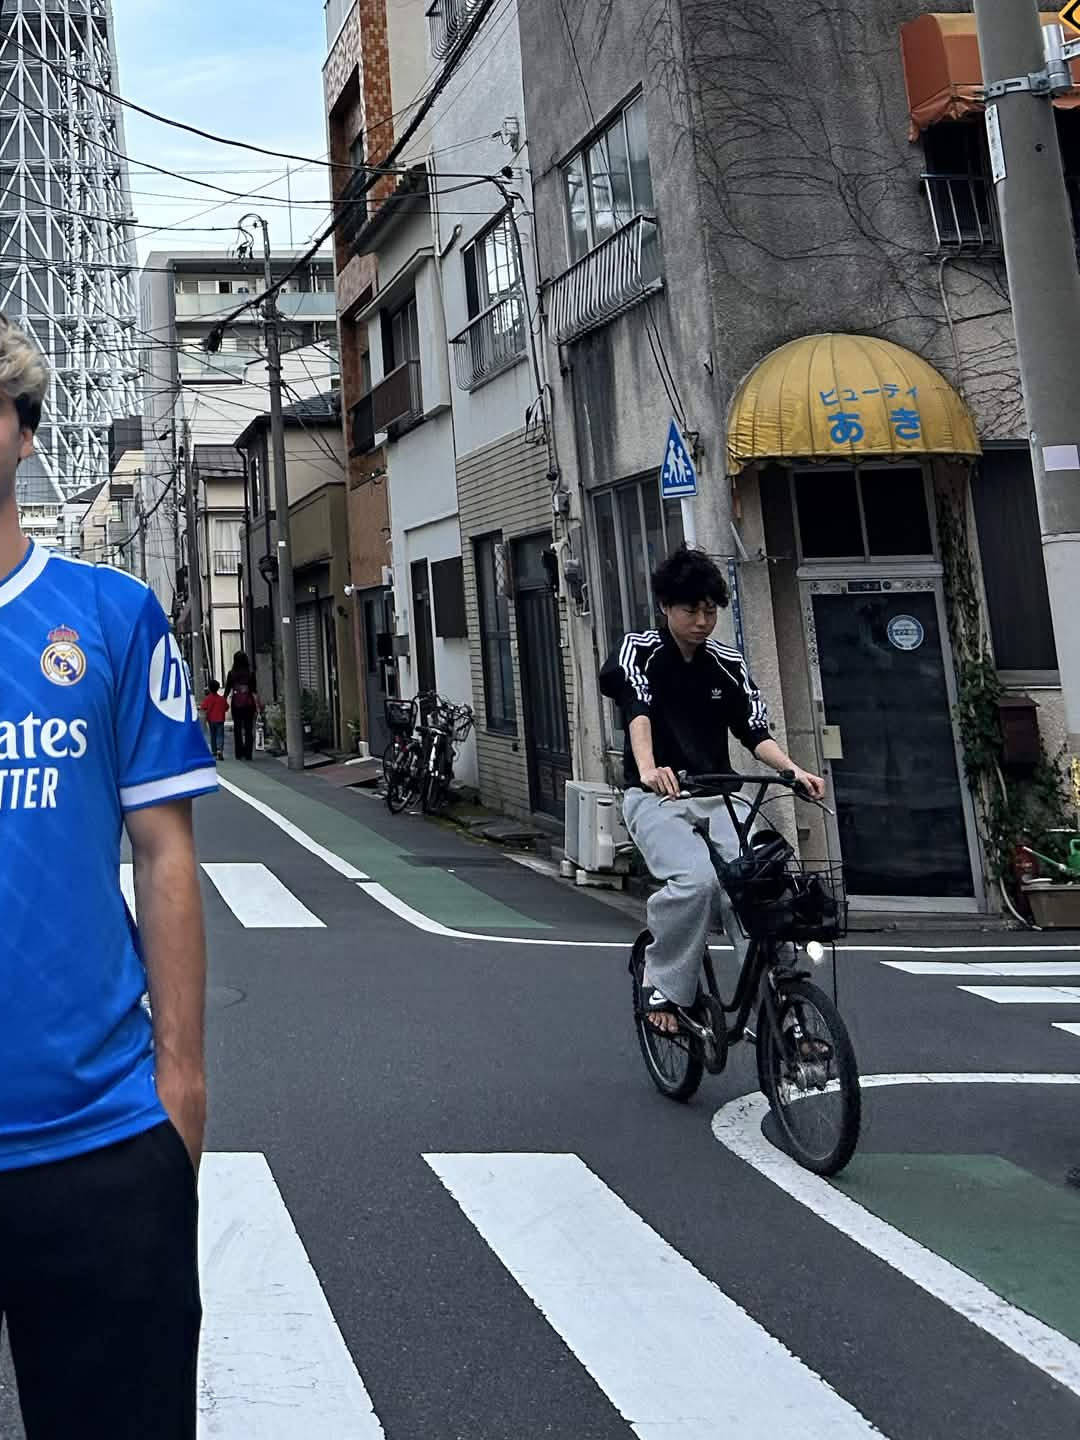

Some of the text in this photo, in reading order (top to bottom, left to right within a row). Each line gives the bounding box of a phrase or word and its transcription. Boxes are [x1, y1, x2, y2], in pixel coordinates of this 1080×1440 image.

[819, 383, 917, 406] ビューティ
[827, 407, 921, 444] あき
